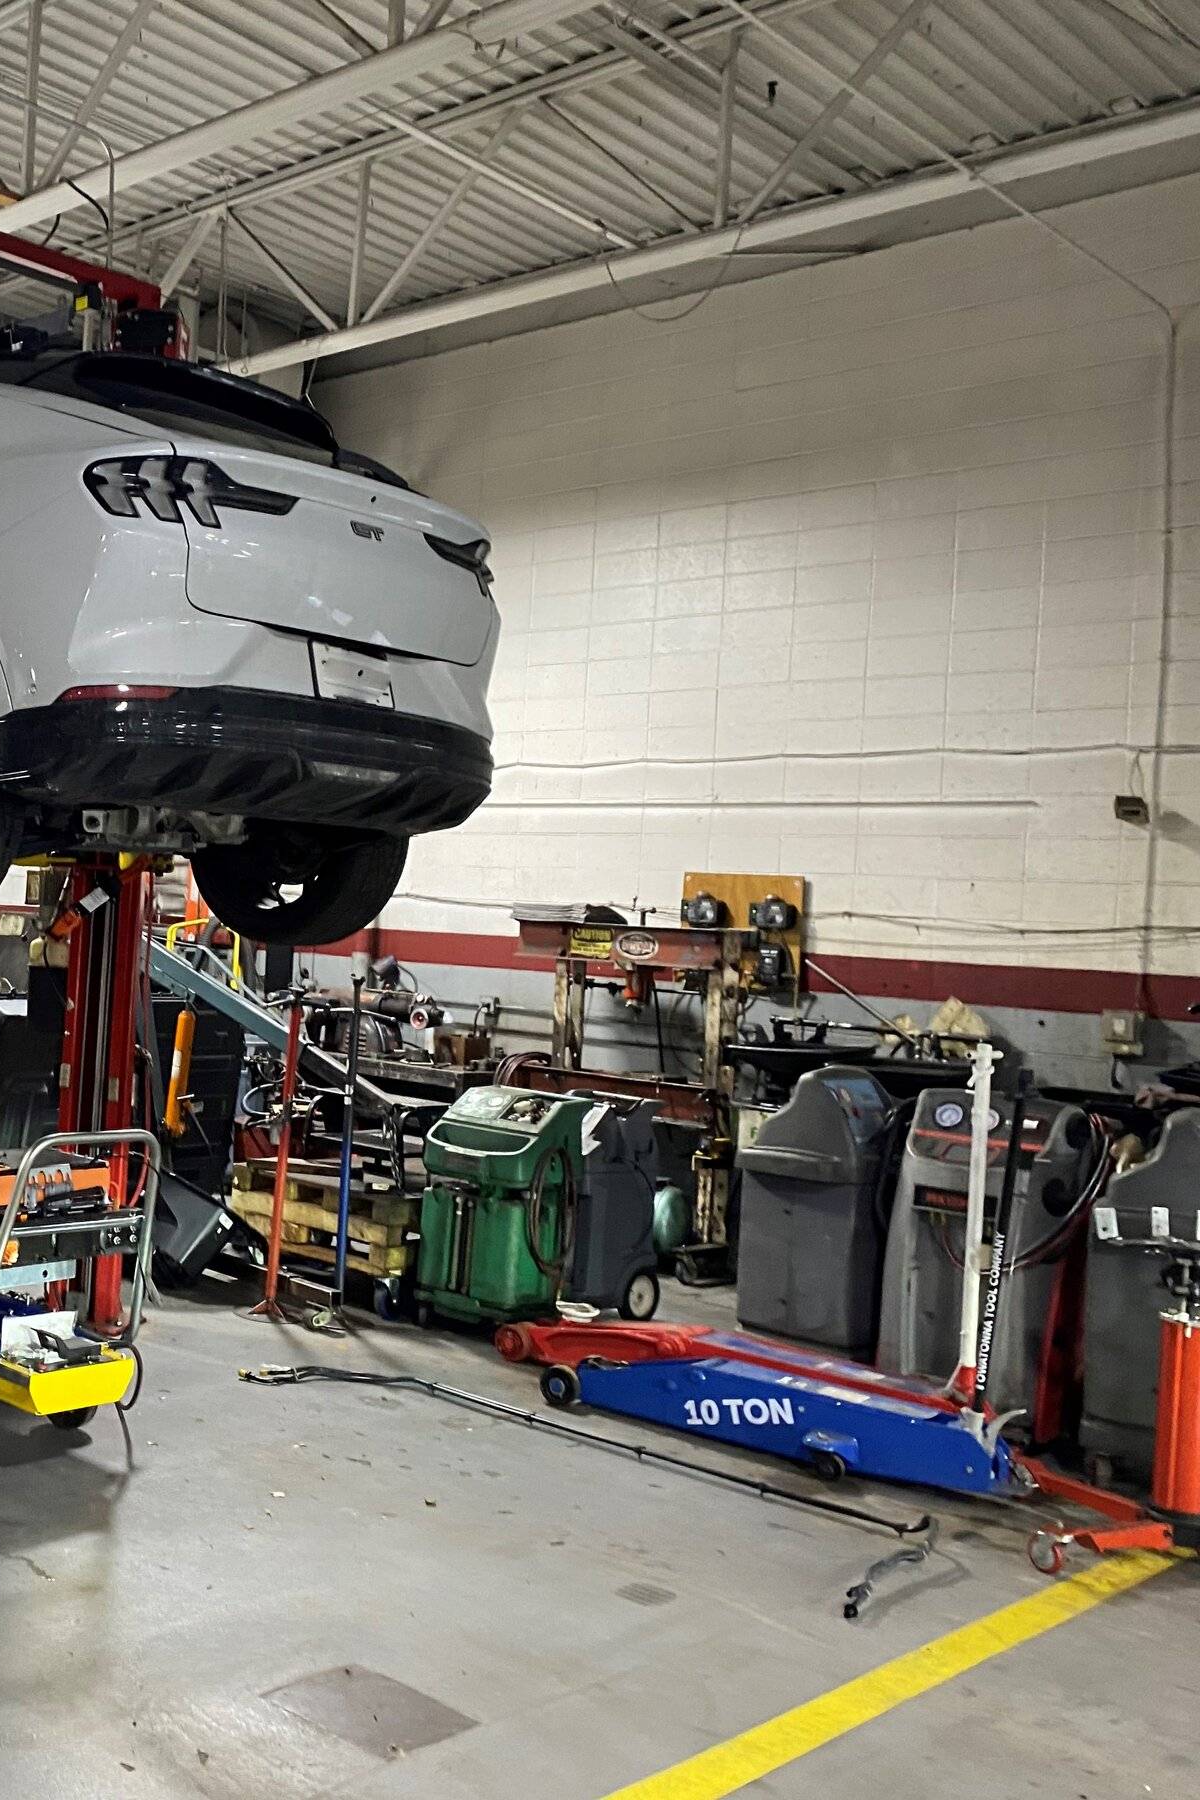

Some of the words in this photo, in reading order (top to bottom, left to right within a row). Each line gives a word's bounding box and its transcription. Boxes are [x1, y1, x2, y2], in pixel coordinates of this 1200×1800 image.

[349, 519, 384, 541] GT
[989, 1231, 1006, 1287] COMPANY
[984, 1288, 999, 1318] TOOL
[683, 1399, 720, 1425] 10
[721, 1398, 795, 1425] TON
